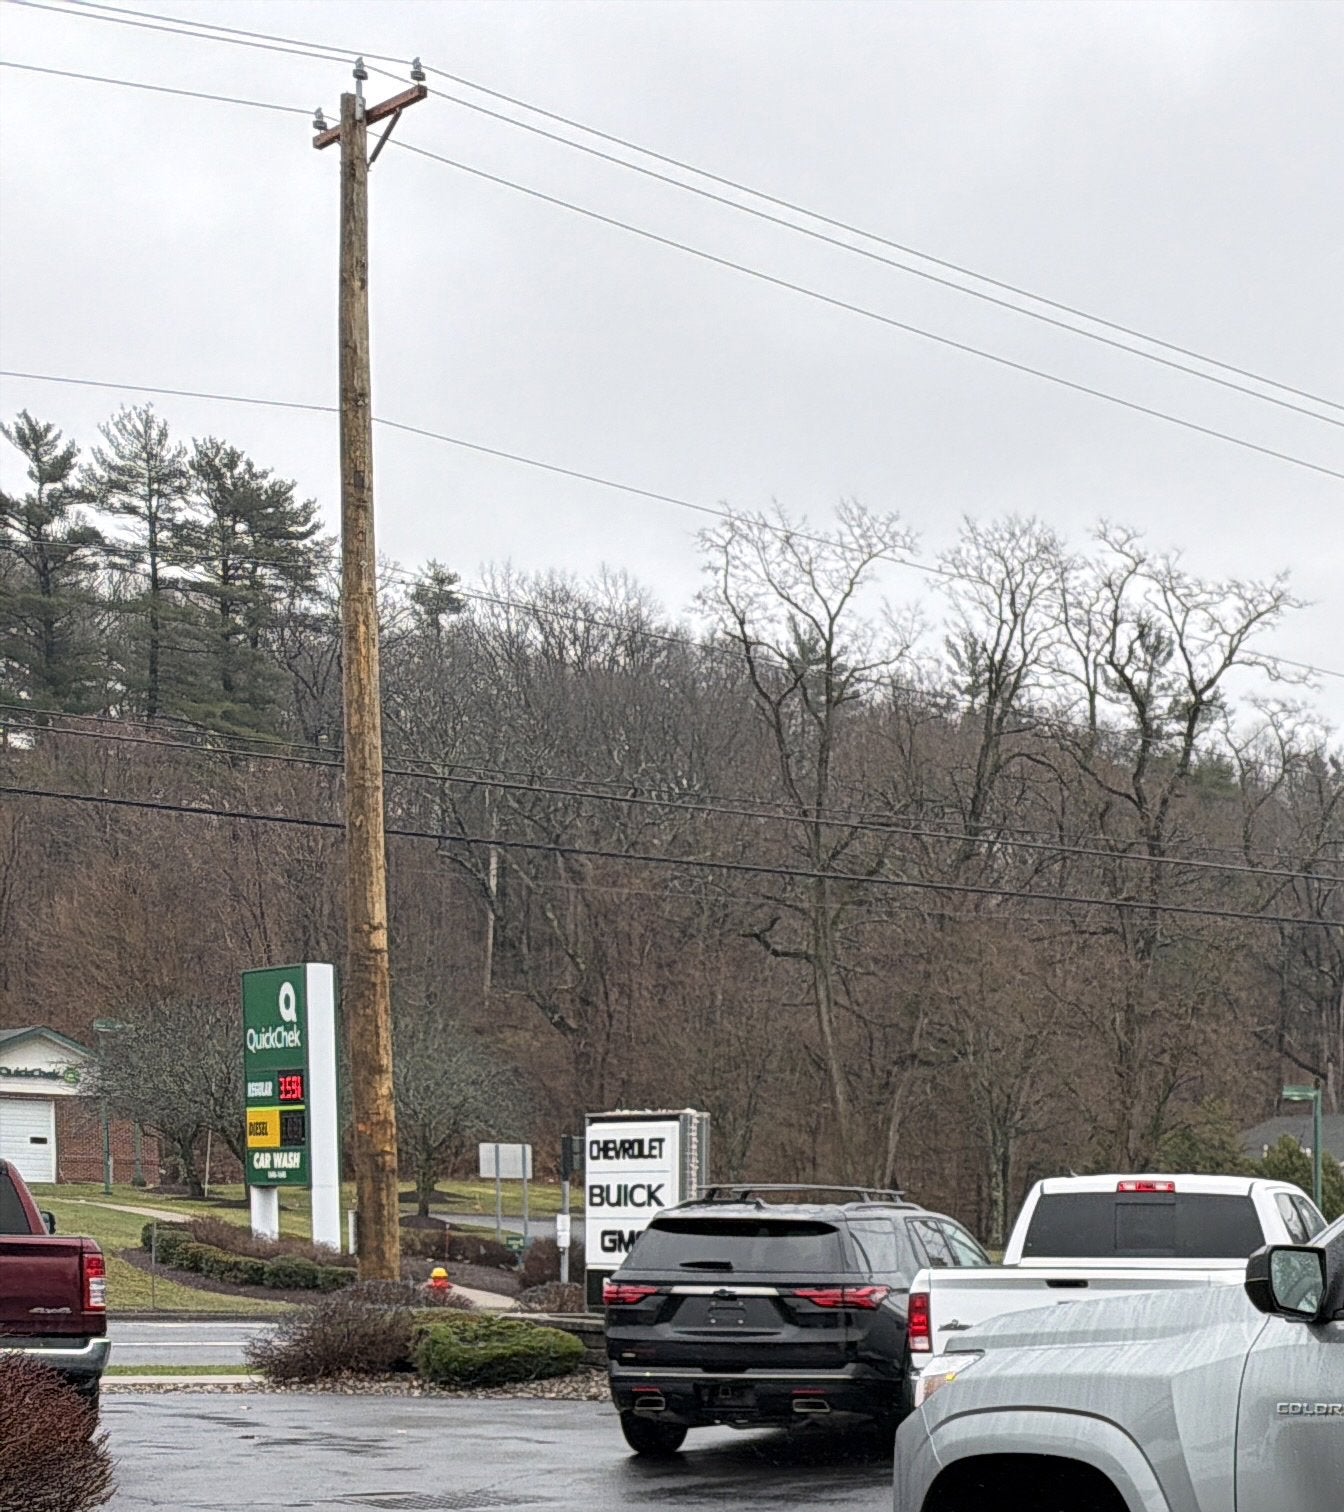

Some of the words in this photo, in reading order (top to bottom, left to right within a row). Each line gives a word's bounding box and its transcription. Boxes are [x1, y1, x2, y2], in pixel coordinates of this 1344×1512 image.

[246, 1024, 302, 1053] QuickChek
[246, 1081, 273, 1098] REGULAR
[248, 1121, 269, 1137] DIESEL
[589, 1137, 666, 1161] CHEVROLET
[253, 1152, 272, 1169] CAR
[273, 1151, 301, 1169] WASH
[588, 1183, 665, 1208] BUICK
